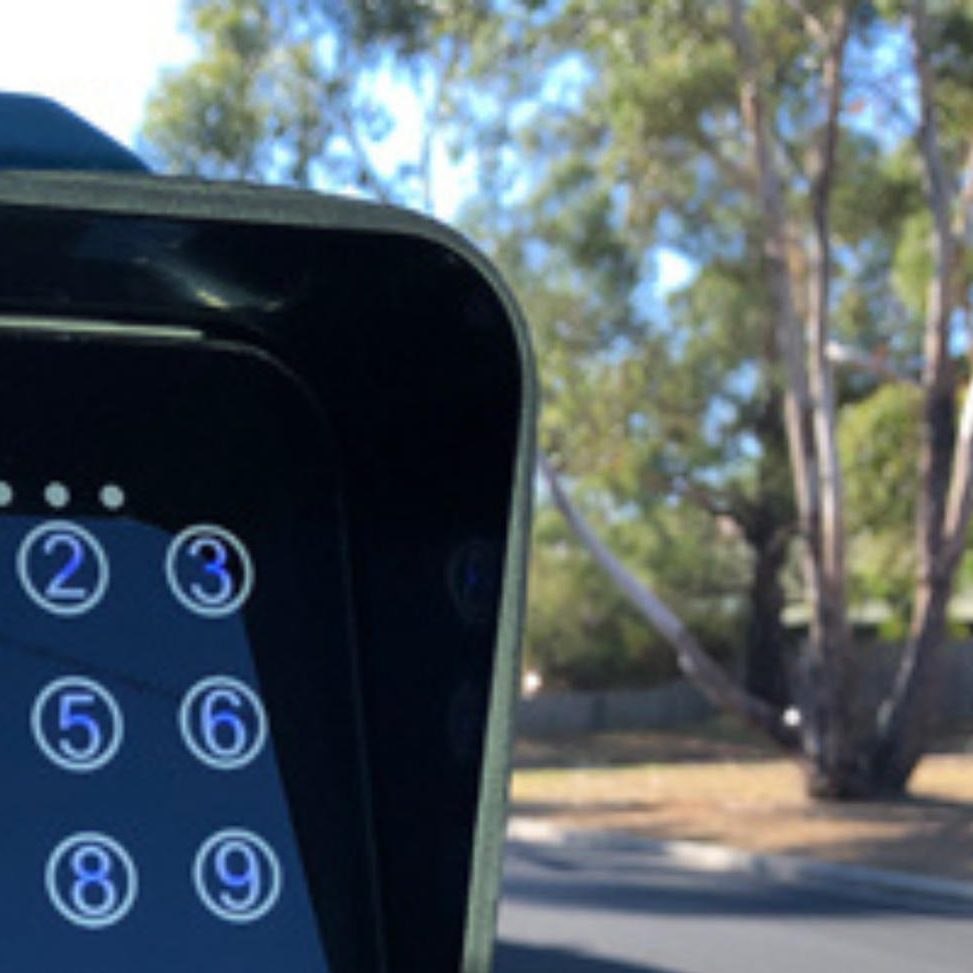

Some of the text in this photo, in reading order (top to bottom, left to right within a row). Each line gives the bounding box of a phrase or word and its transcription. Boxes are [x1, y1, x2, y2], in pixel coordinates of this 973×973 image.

[43, 533, 86, 600] 2
[189, 538, 231, 605] 3
[57, 694, 103, 760] 5
[200, 689, 248, 758] 6
[70, 845, 117, 917] 8
[214, 842, 262, 912] 9
